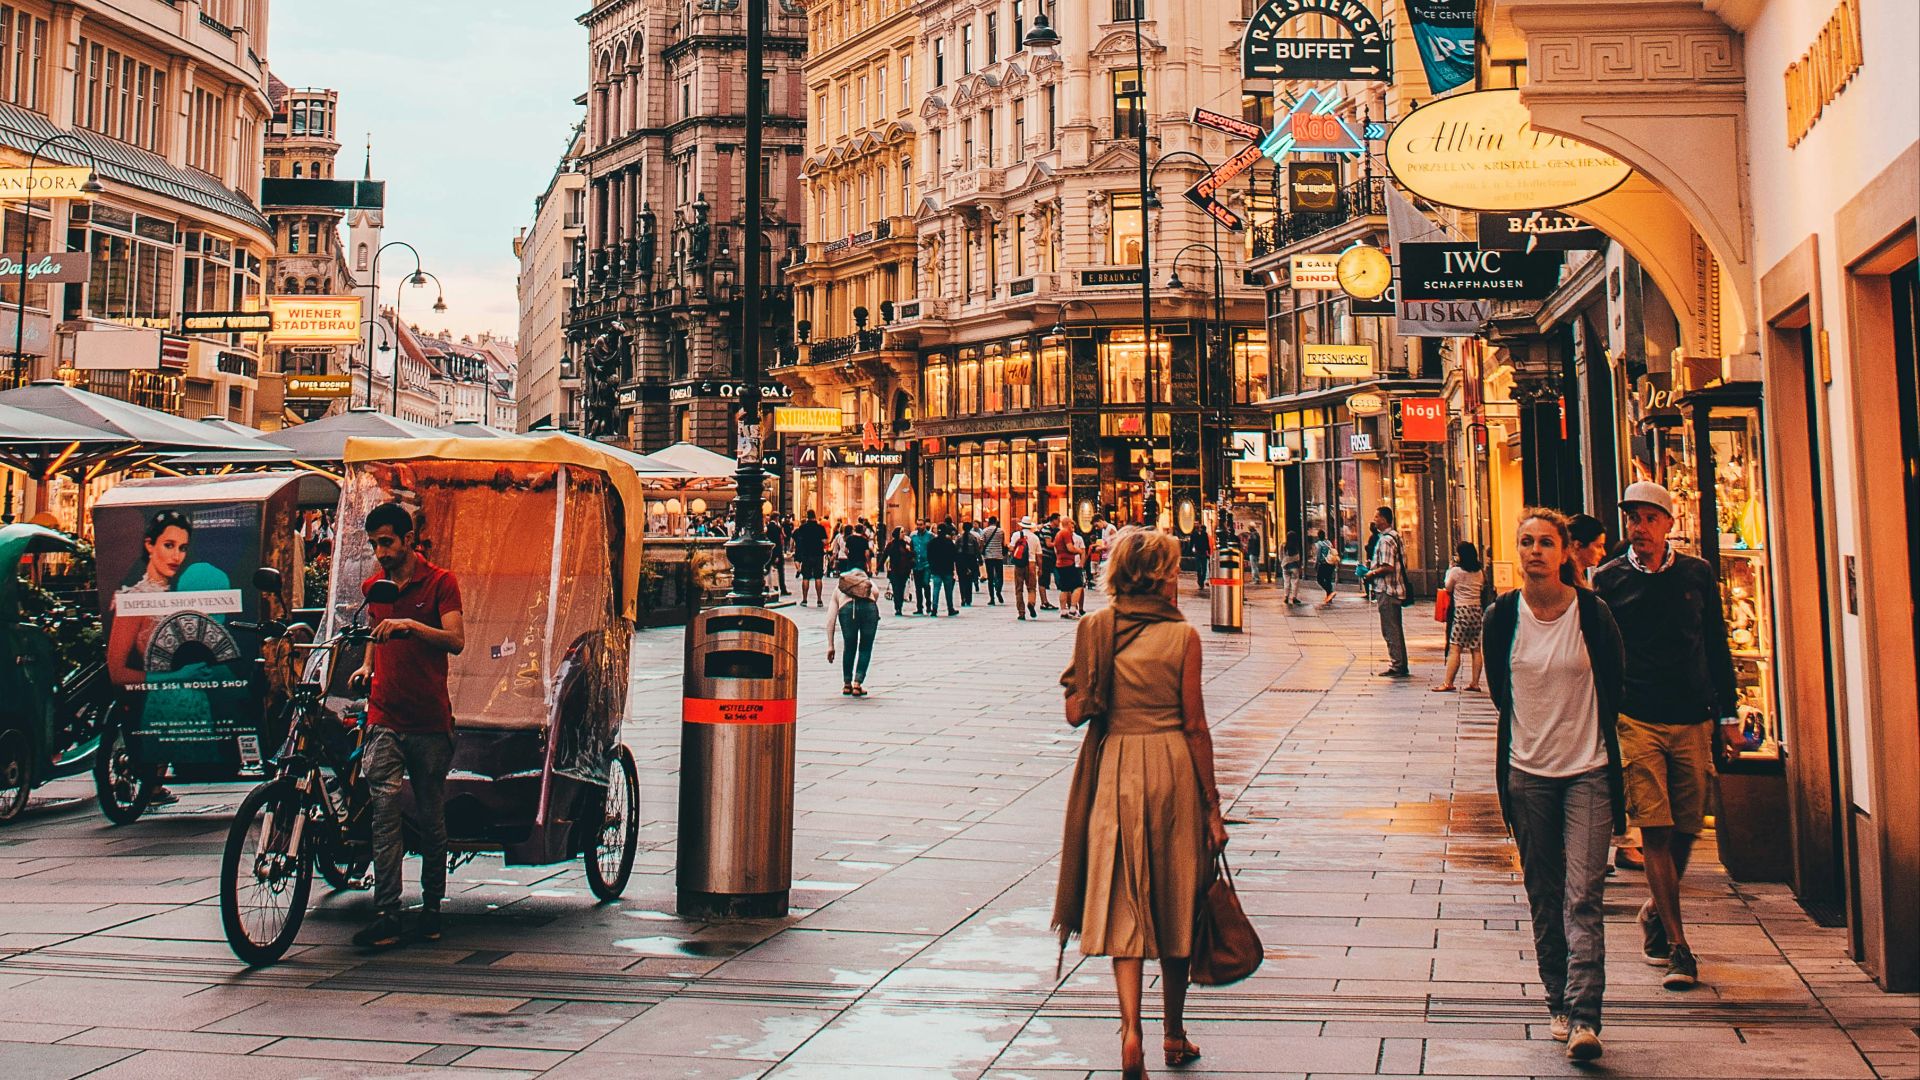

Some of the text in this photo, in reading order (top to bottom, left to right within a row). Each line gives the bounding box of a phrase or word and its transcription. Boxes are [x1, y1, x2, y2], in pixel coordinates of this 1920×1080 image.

[1439, 11, 1477, 19] CENTE
[1276, 43, 1354, 59] BUFFET
[1198, 110, 1260, 135] DISCOTHEQUE
[1406, 121, 1503, 153] Albin
[1407, 158, 1619, 172] PORZELLAN KRISTALL GESCHENKE
[0, 176, 77, 190] ANDORA
[1508, 217, 1579, 233] BALLY
[1443, 251, 1501, 274] IWC
[1098, 272, 1124, 282] BRAUN
[1424, 280, 1523, 289] SCHAFFHAUSEN
[289, 309, 341, 318] WIENER
[1403, 302, 1484, 322] LISKA
[185, 316, 270, 329] GERRY WEBER
[1350, 433, 1371, 451] FOSSIL
[123, 596, 235, 609] IMPERIAL SHOP VIENNA
[125, 680, 248, 691] WHERE SISI WOULD SHOP
